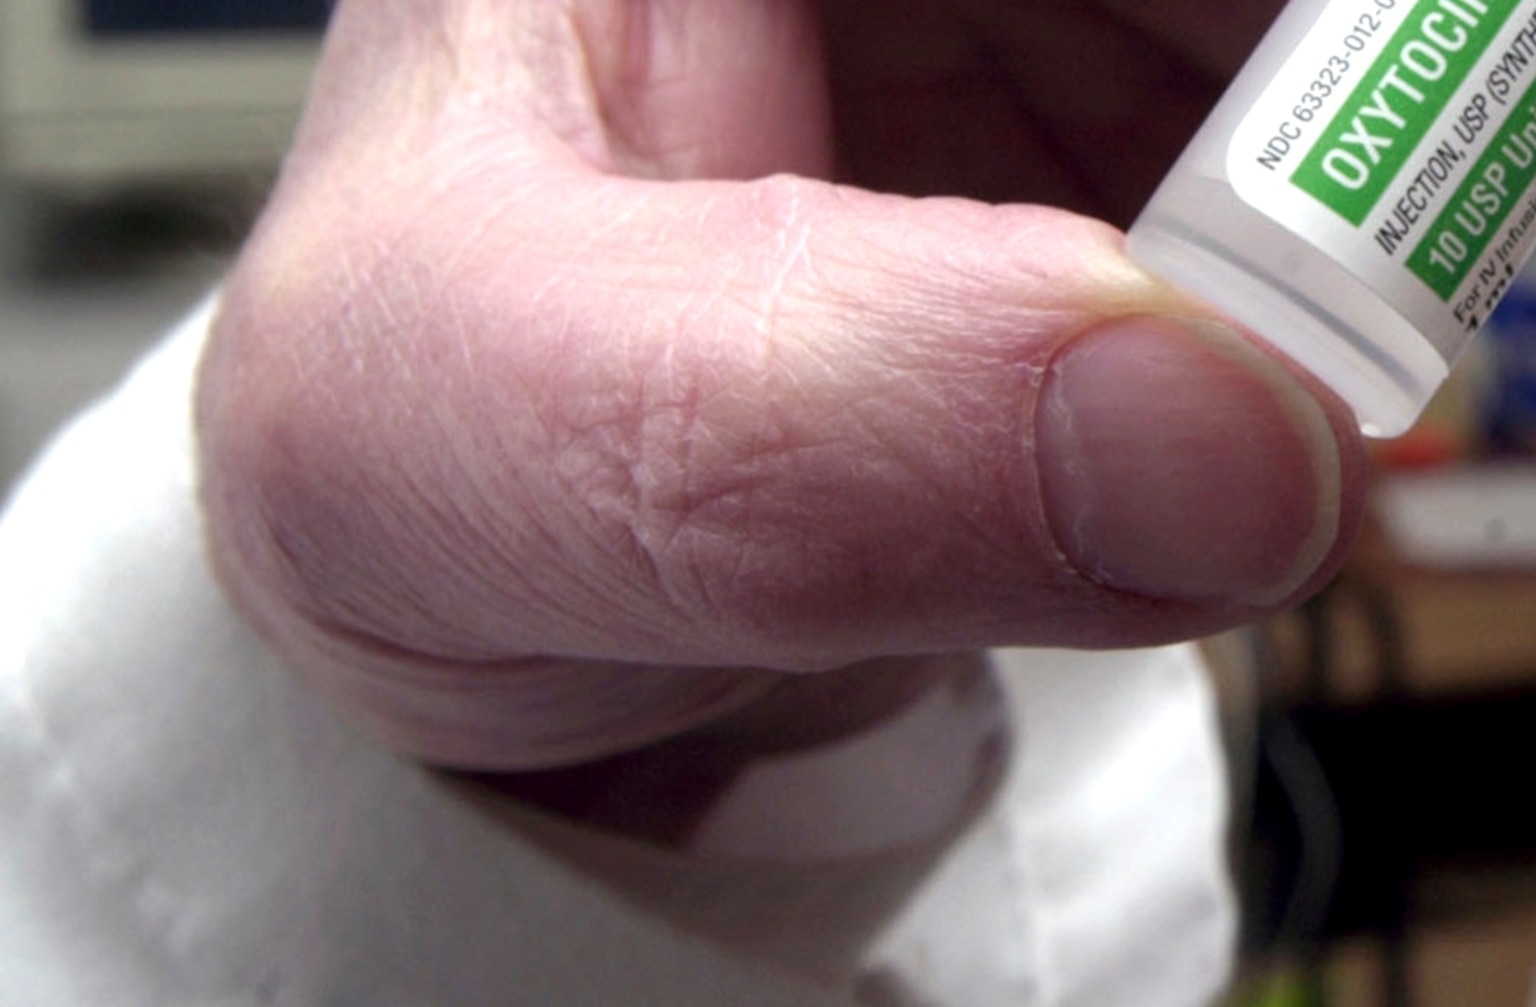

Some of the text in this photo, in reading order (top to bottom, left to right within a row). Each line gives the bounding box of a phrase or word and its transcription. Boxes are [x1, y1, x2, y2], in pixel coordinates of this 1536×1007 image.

[1257, 122, 1300, 171] NDC
[1374, 140, 1467, 255] INJECTION,
[1453, 93, 1489, 144] USP
[1429, 230, 1468, 275] 10
[1454, 162, 1509, 236] USP
[1453, 284, 1481, 324] For
[1478, 259, 1496, 285] IV
